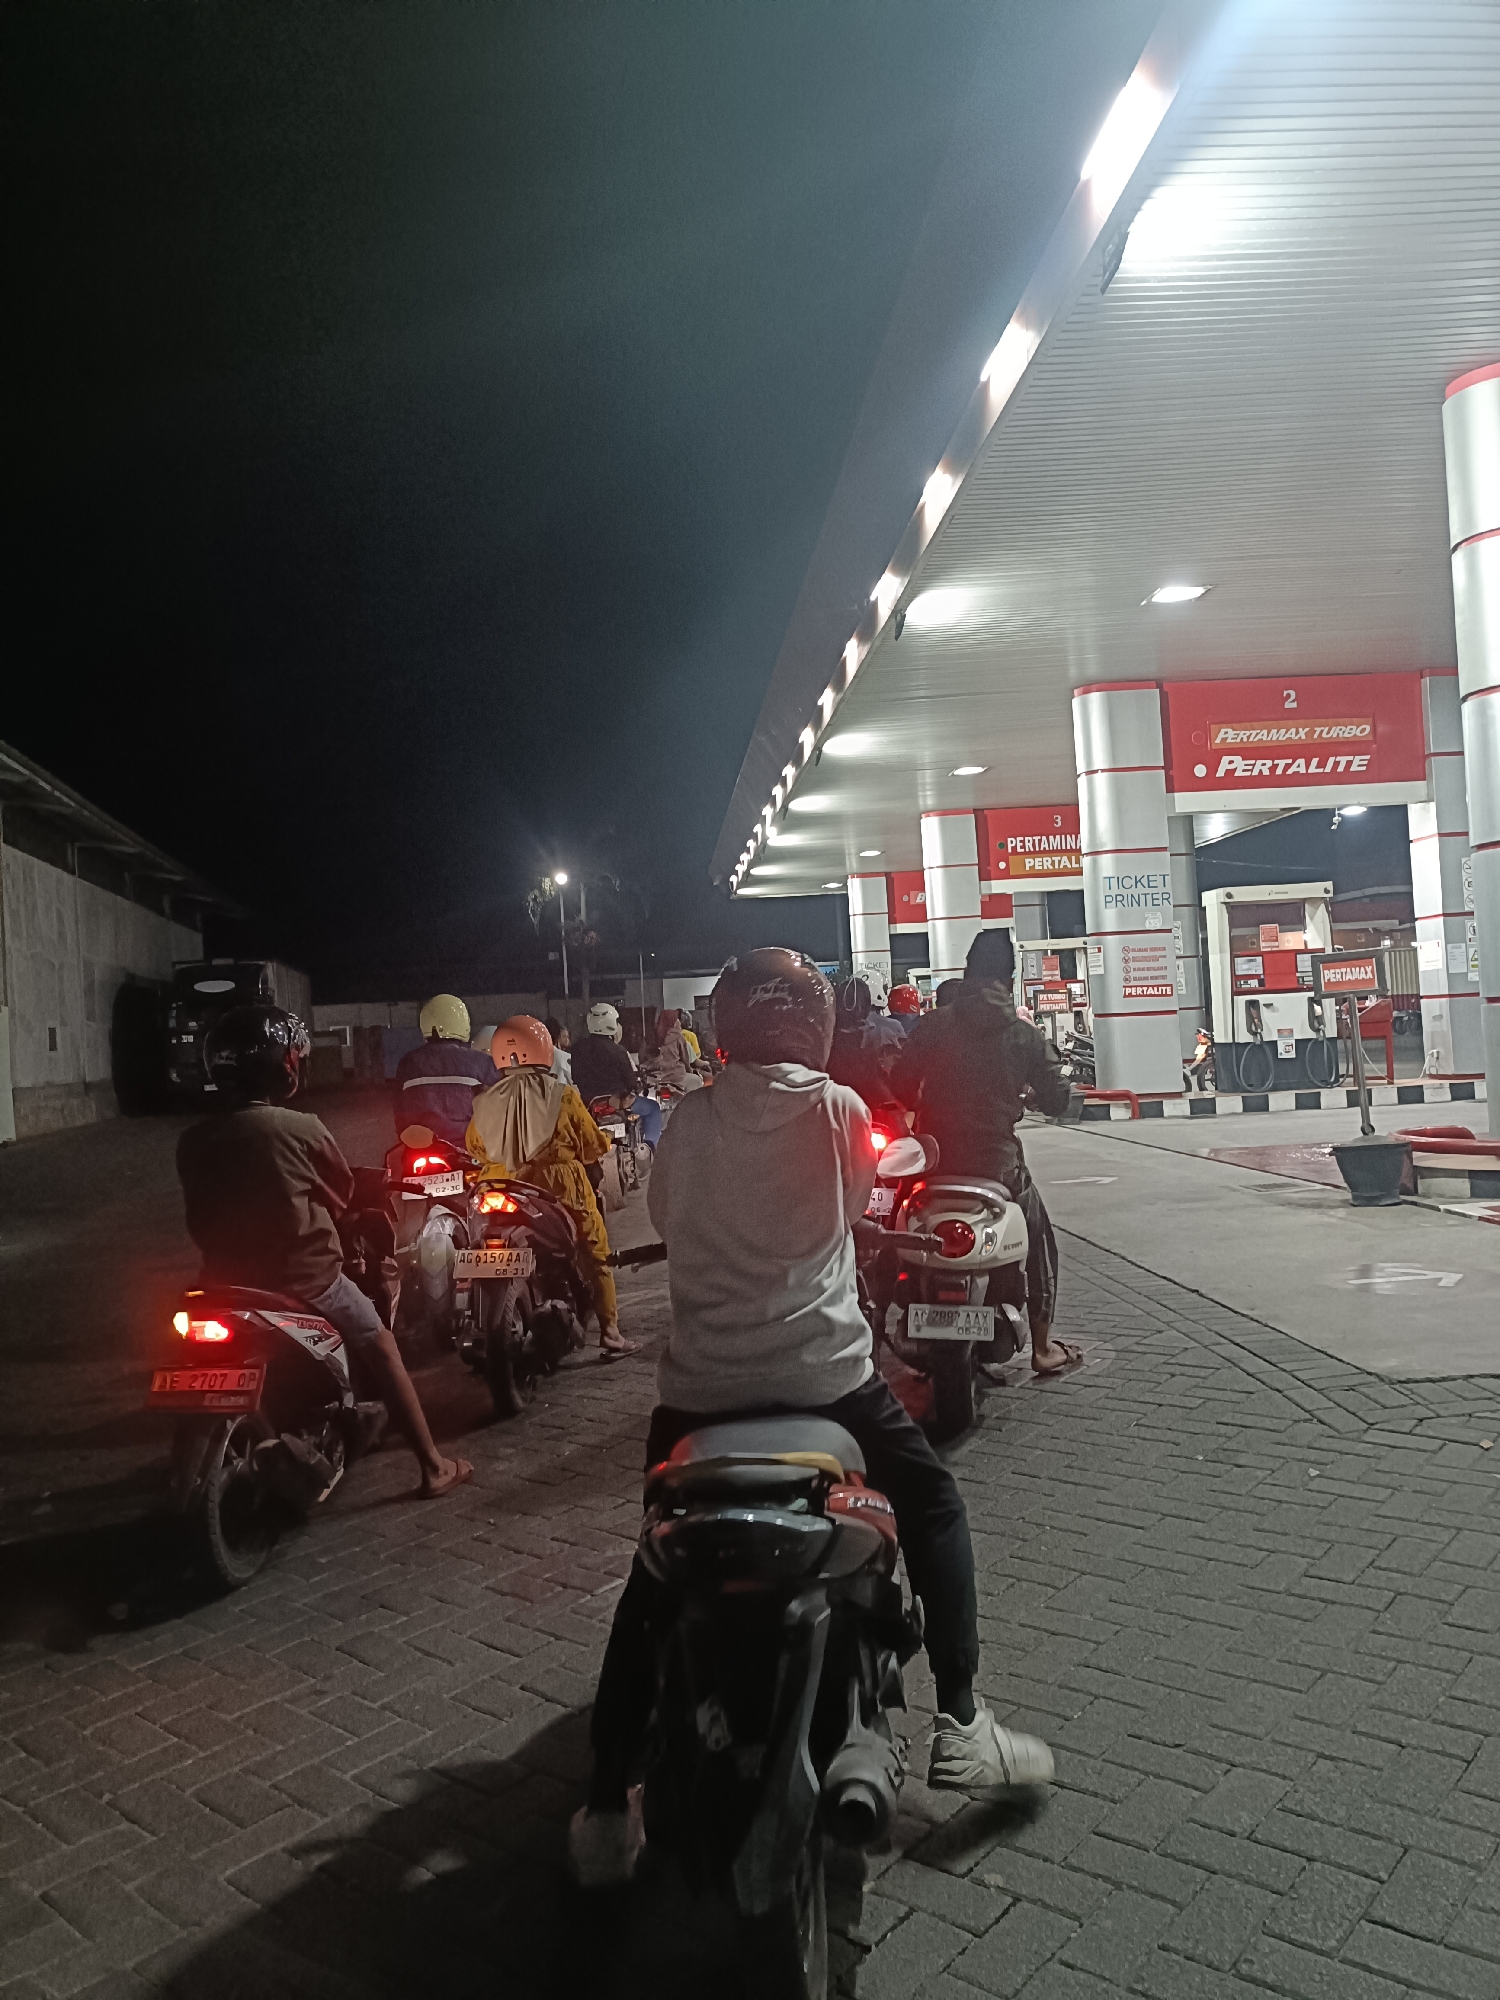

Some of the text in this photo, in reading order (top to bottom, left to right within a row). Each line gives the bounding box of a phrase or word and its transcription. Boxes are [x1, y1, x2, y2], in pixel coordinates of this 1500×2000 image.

[1283, 689, 1297, 709] 2
[1214, 724, 1371, 744] PERTAMAX TURBO
[1215, 754, 1371, 778] PERTALITE
[1053, 814, 1062, 828] 3
[1103, 873, 1170, 891] TICKET
[1104, 891, 1172, 909] PRINTER
[859, 961, 889, 969] TICKET
[1323, 965, 1373, 983] PERTAMAX
[1125, 986, 1172, 996] PERTALITE
[421, 1174, 445, 1187] 2523
[450, 1172, 461, 1182] AT
[187, 1372, 228, 1389] 2707
